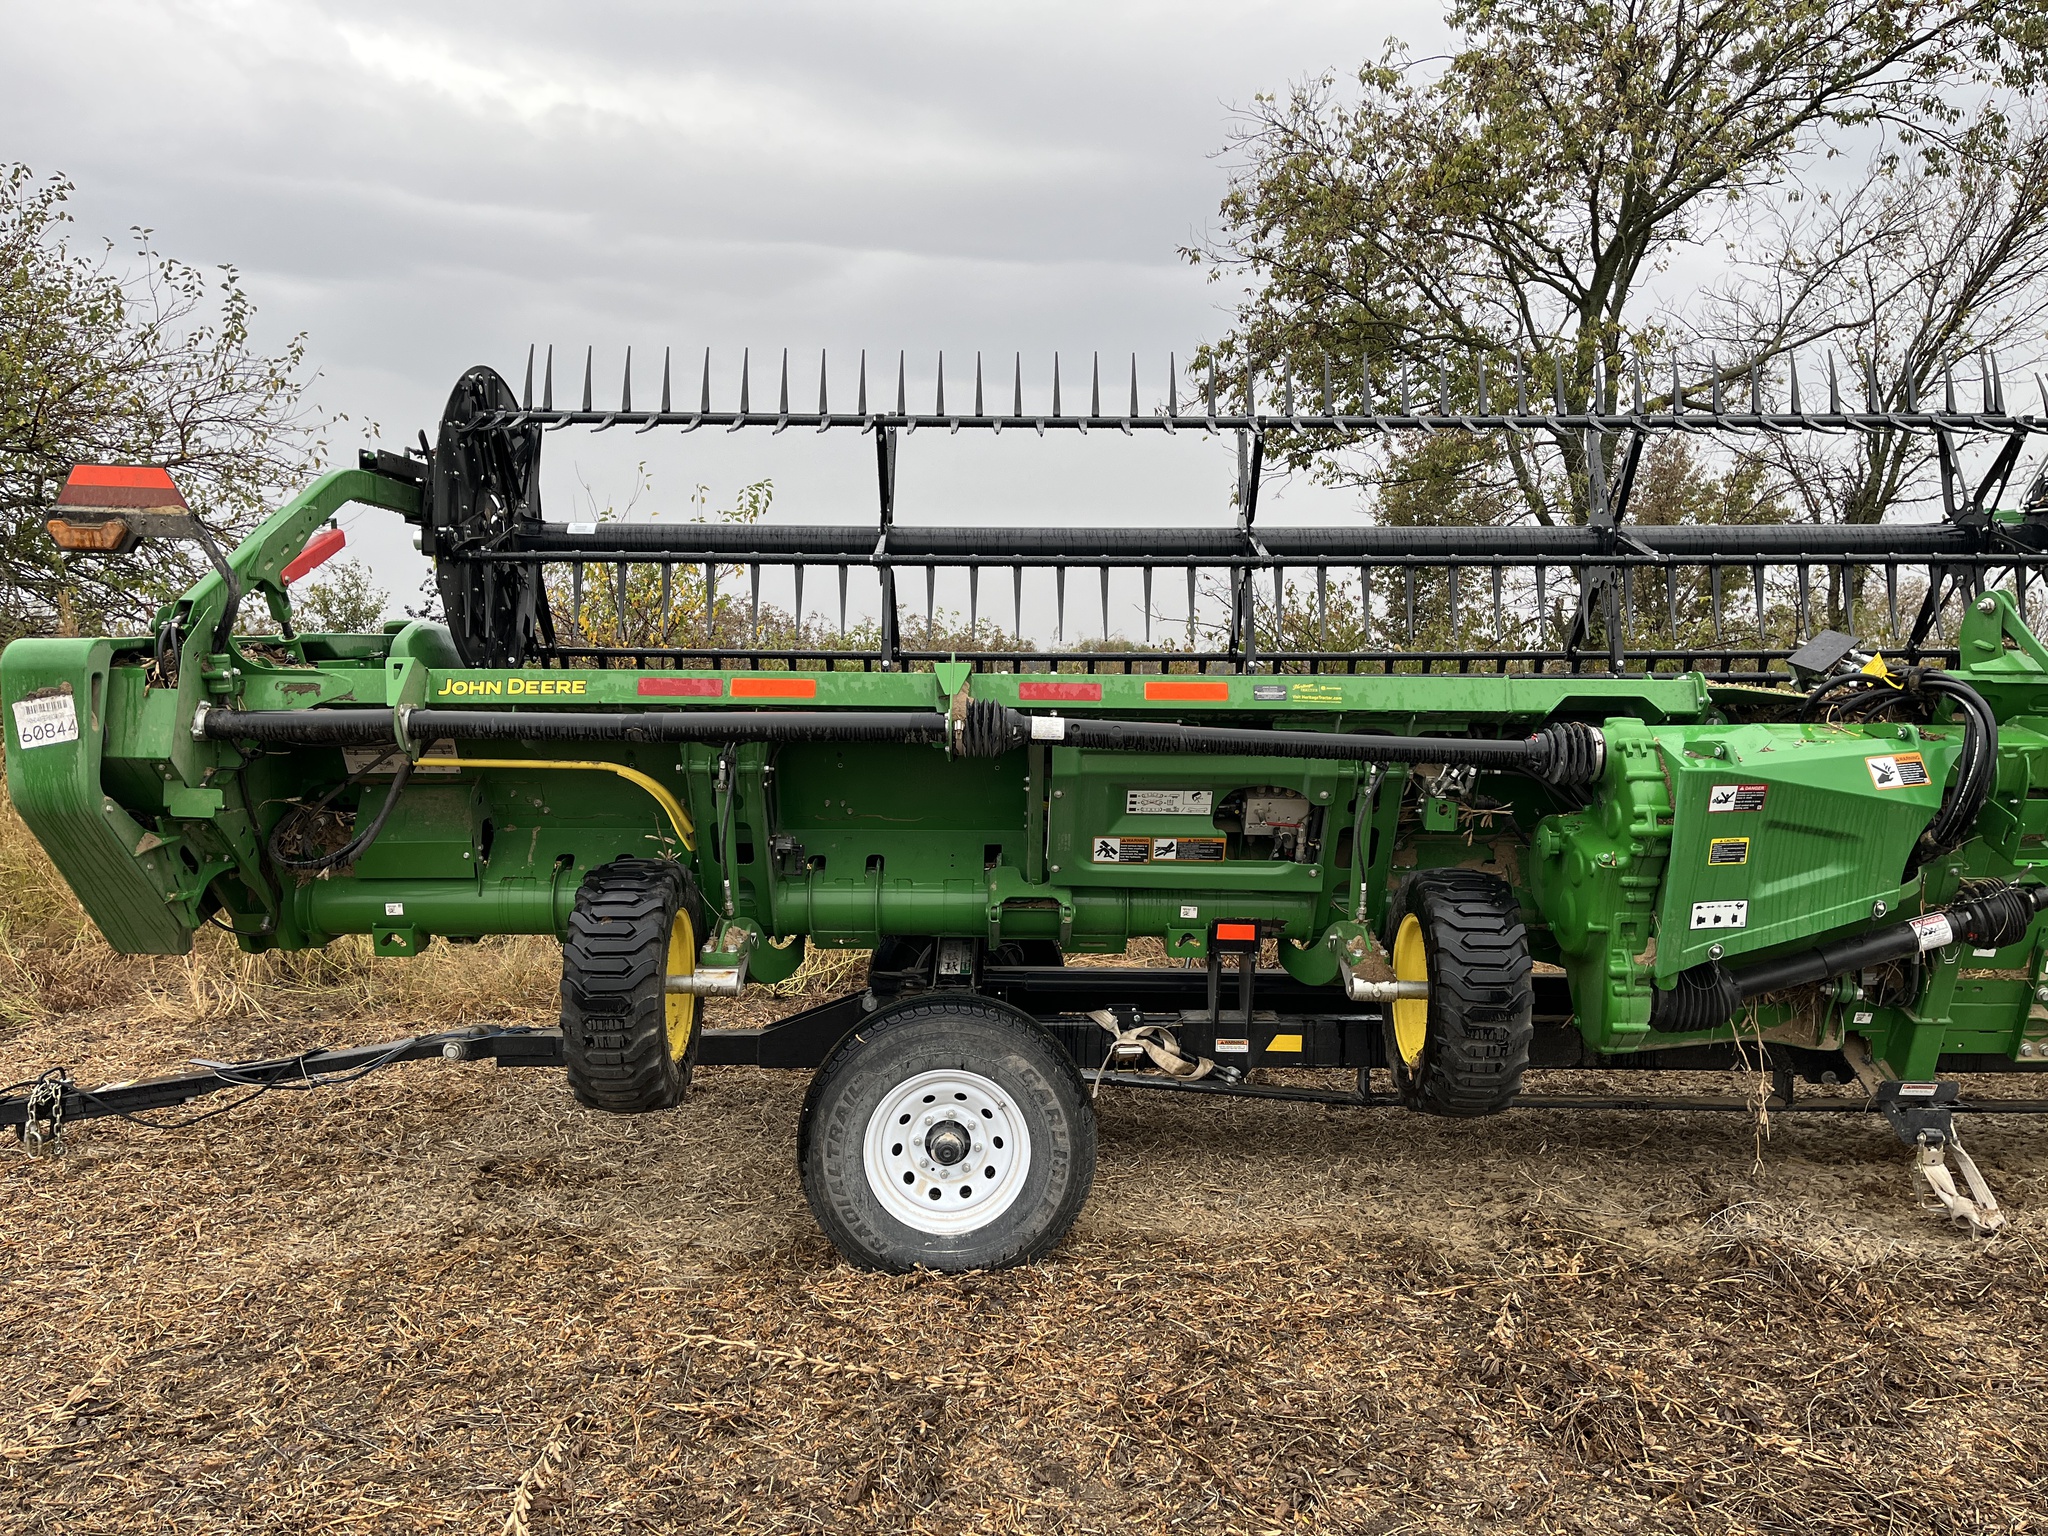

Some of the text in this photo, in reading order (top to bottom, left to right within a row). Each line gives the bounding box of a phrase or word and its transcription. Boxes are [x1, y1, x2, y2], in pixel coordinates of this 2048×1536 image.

[437, 677, 586, 695] JOHN DEERE
[22, 719, 77, 743] 60844
[1019, 1068, 1068, 1222] CARLISLE
